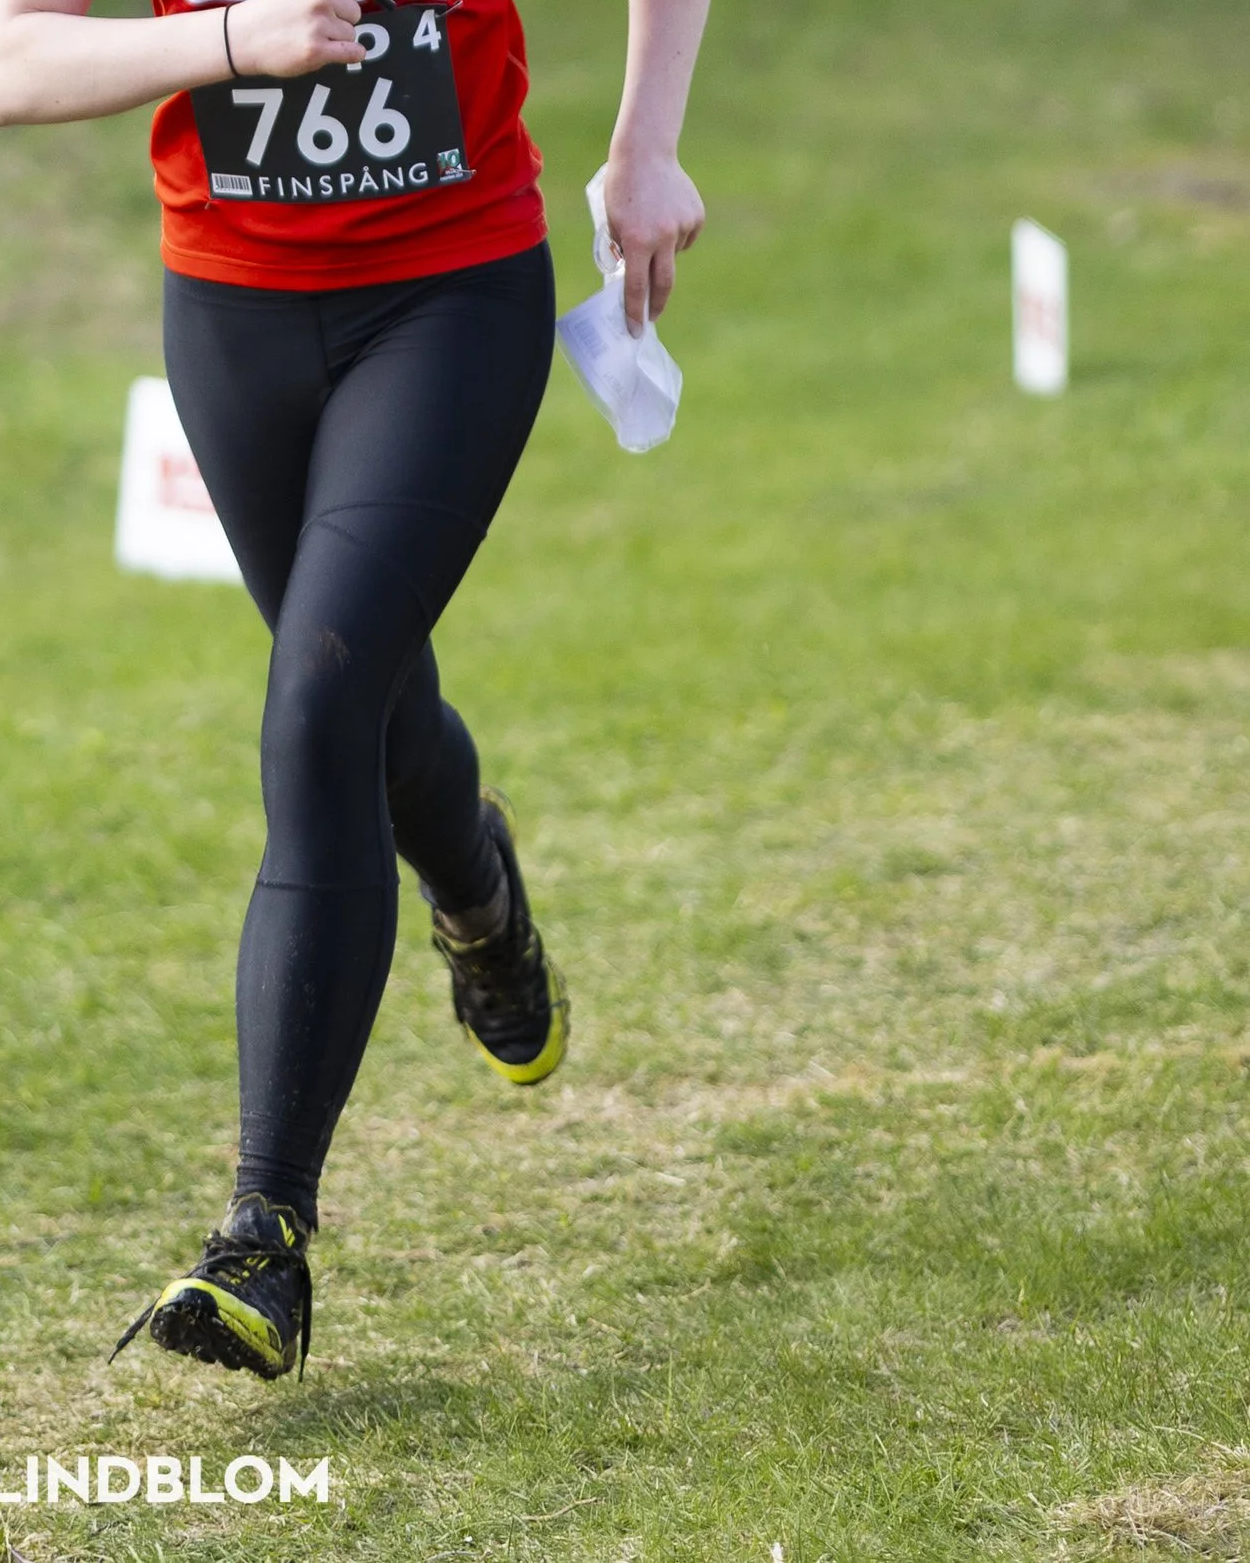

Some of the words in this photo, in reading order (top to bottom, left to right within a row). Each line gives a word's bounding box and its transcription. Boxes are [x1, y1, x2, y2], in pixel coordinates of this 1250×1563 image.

[412, 8, 442, 52] 4
[231, 77, 411, 167] 766
[258, 163, 430, 198] FINSPÅNG
